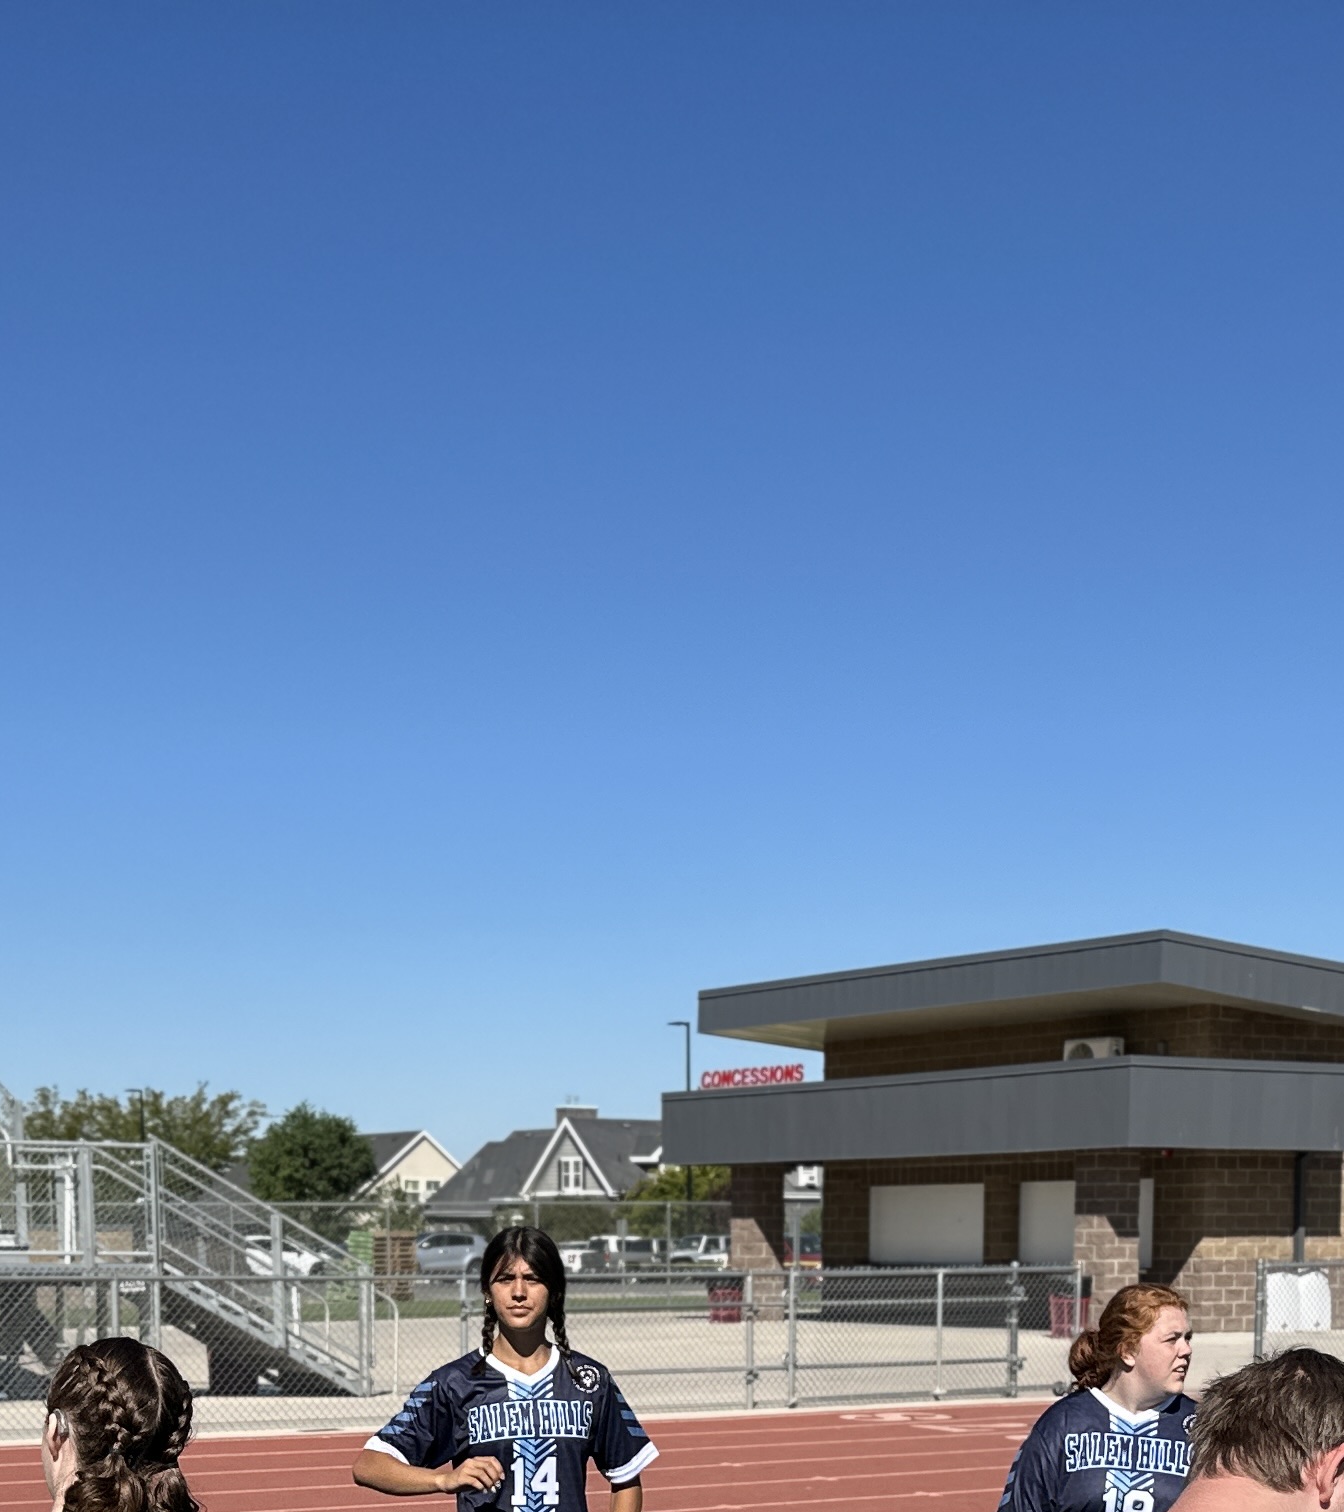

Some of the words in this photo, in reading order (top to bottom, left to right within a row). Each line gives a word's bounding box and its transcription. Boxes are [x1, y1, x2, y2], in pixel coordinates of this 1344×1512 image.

[701, 1063, 804, 1089] CONCESSIONS
[467, 1400, 536, 1445] SALEM
[537, 1399, 594, 1440] HILLS
[1064, 1431, 1134, 1473] SALEM
[510, 1456, 560, 1506] 14
